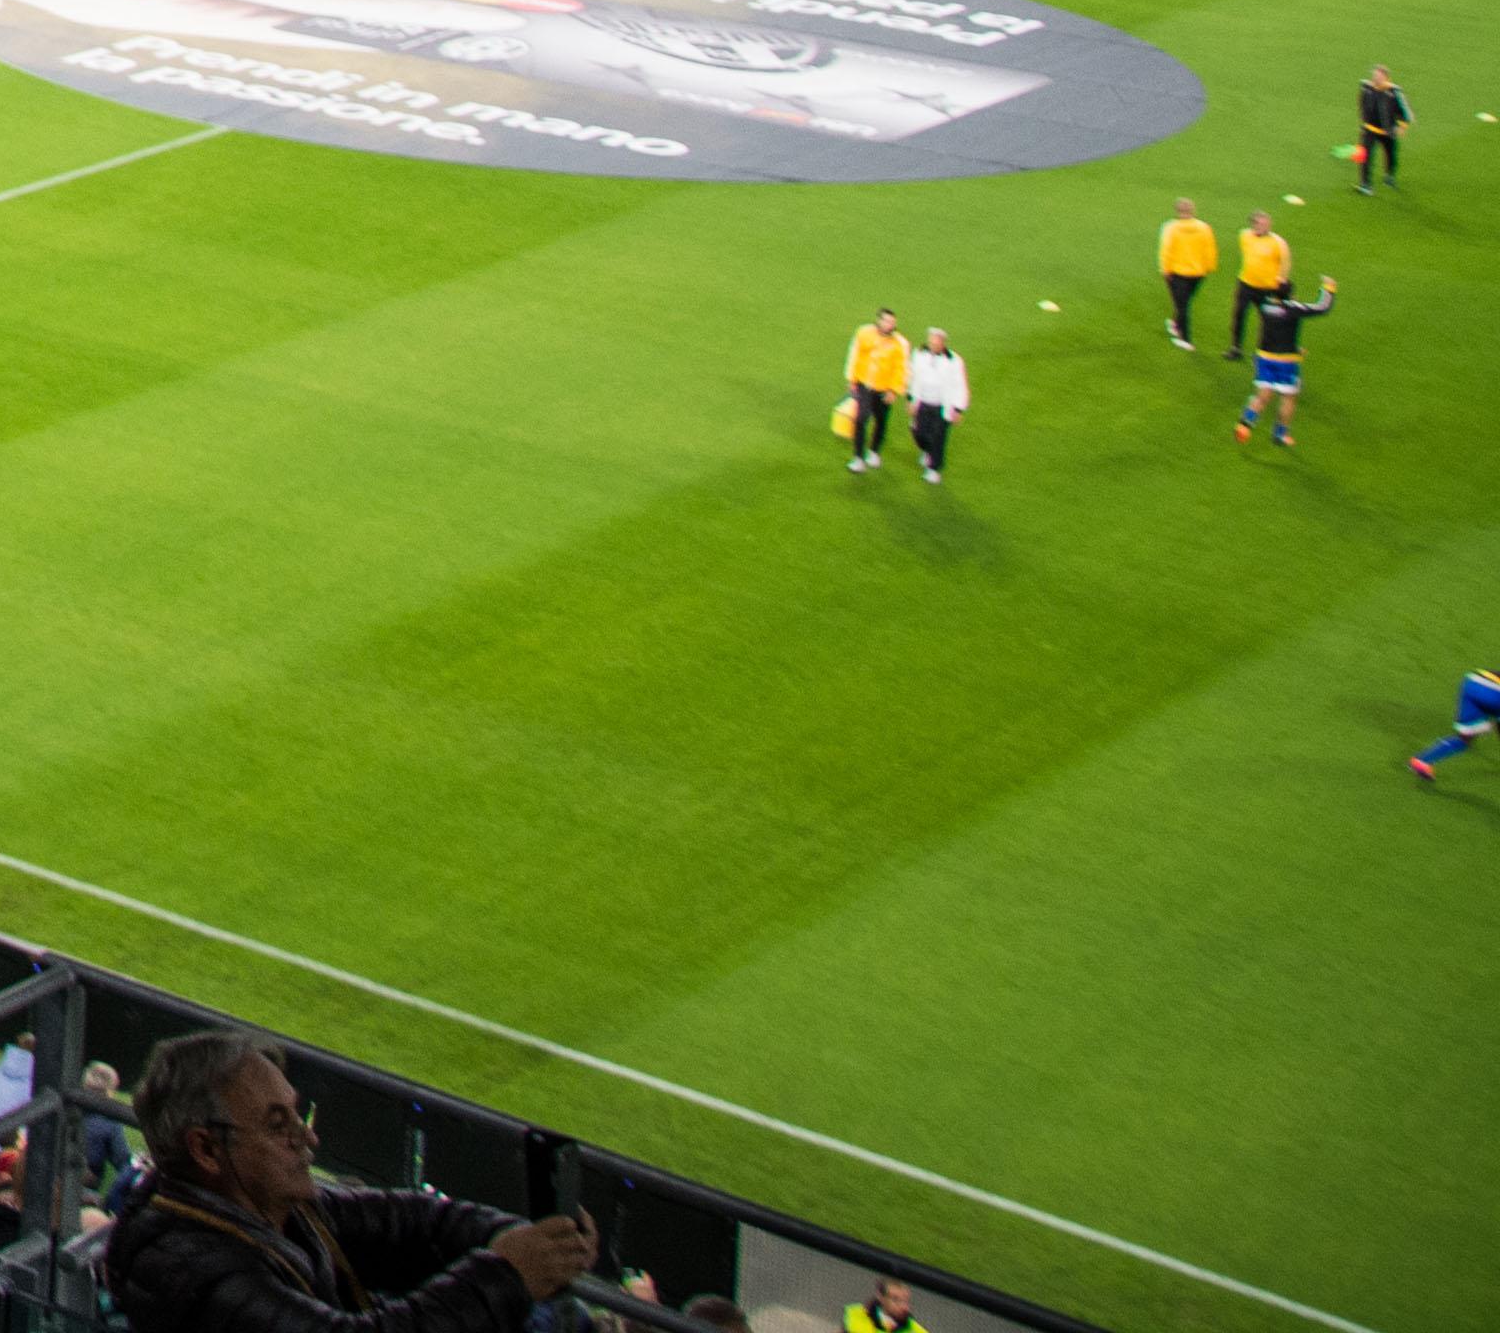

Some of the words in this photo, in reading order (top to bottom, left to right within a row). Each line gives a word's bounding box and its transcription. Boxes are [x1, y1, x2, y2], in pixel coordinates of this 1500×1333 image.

[60, 47, 137, 74] la
[107, 34, 363, 94] Prendi
[361, 80, 439, 110] in
[442, 99, 690, 158] mano
